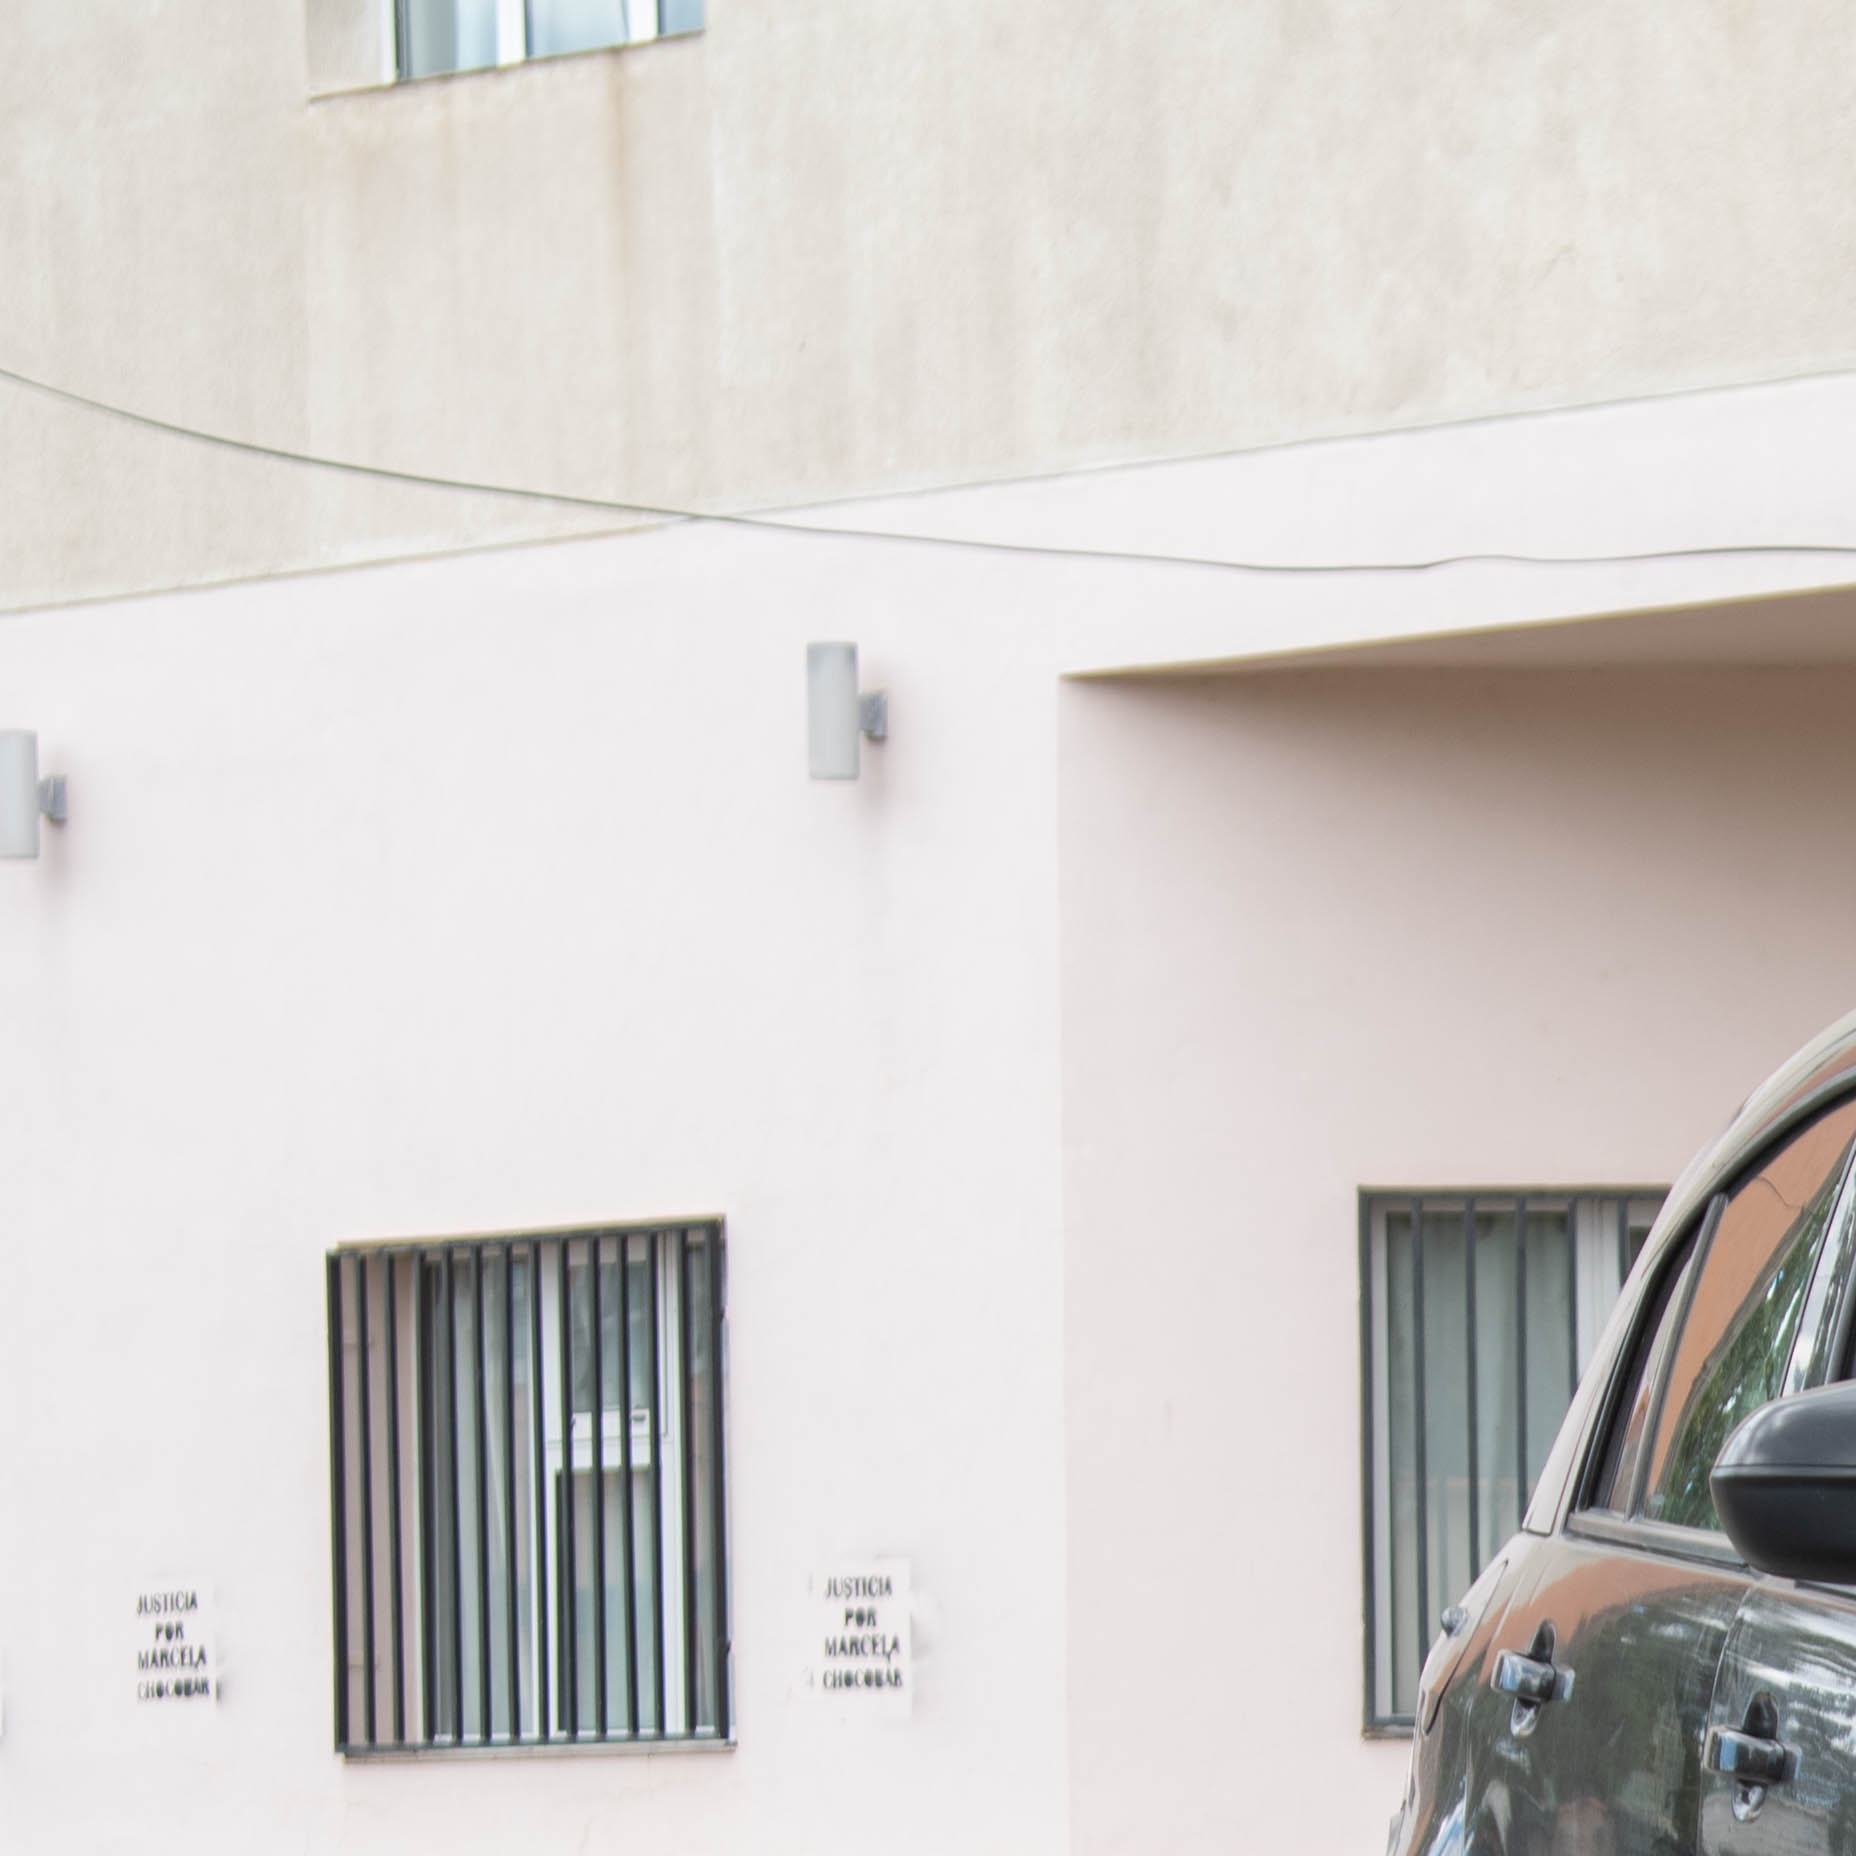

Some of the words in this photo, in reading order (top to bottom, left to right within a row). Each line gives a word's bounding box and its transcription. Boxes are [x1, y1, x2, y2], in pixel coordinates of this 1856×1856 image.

[826, 1574, 892, 1599] JUSTICIA
[136, 1590, 198, 1615] JUSTICIA
[845, 1606, 877, 1627] POR
[155, 1620, 184, 1642] POR
[137, 1644, 207, 1669] MARCELA
[824, 1633, 901, 1663] MARCELA
